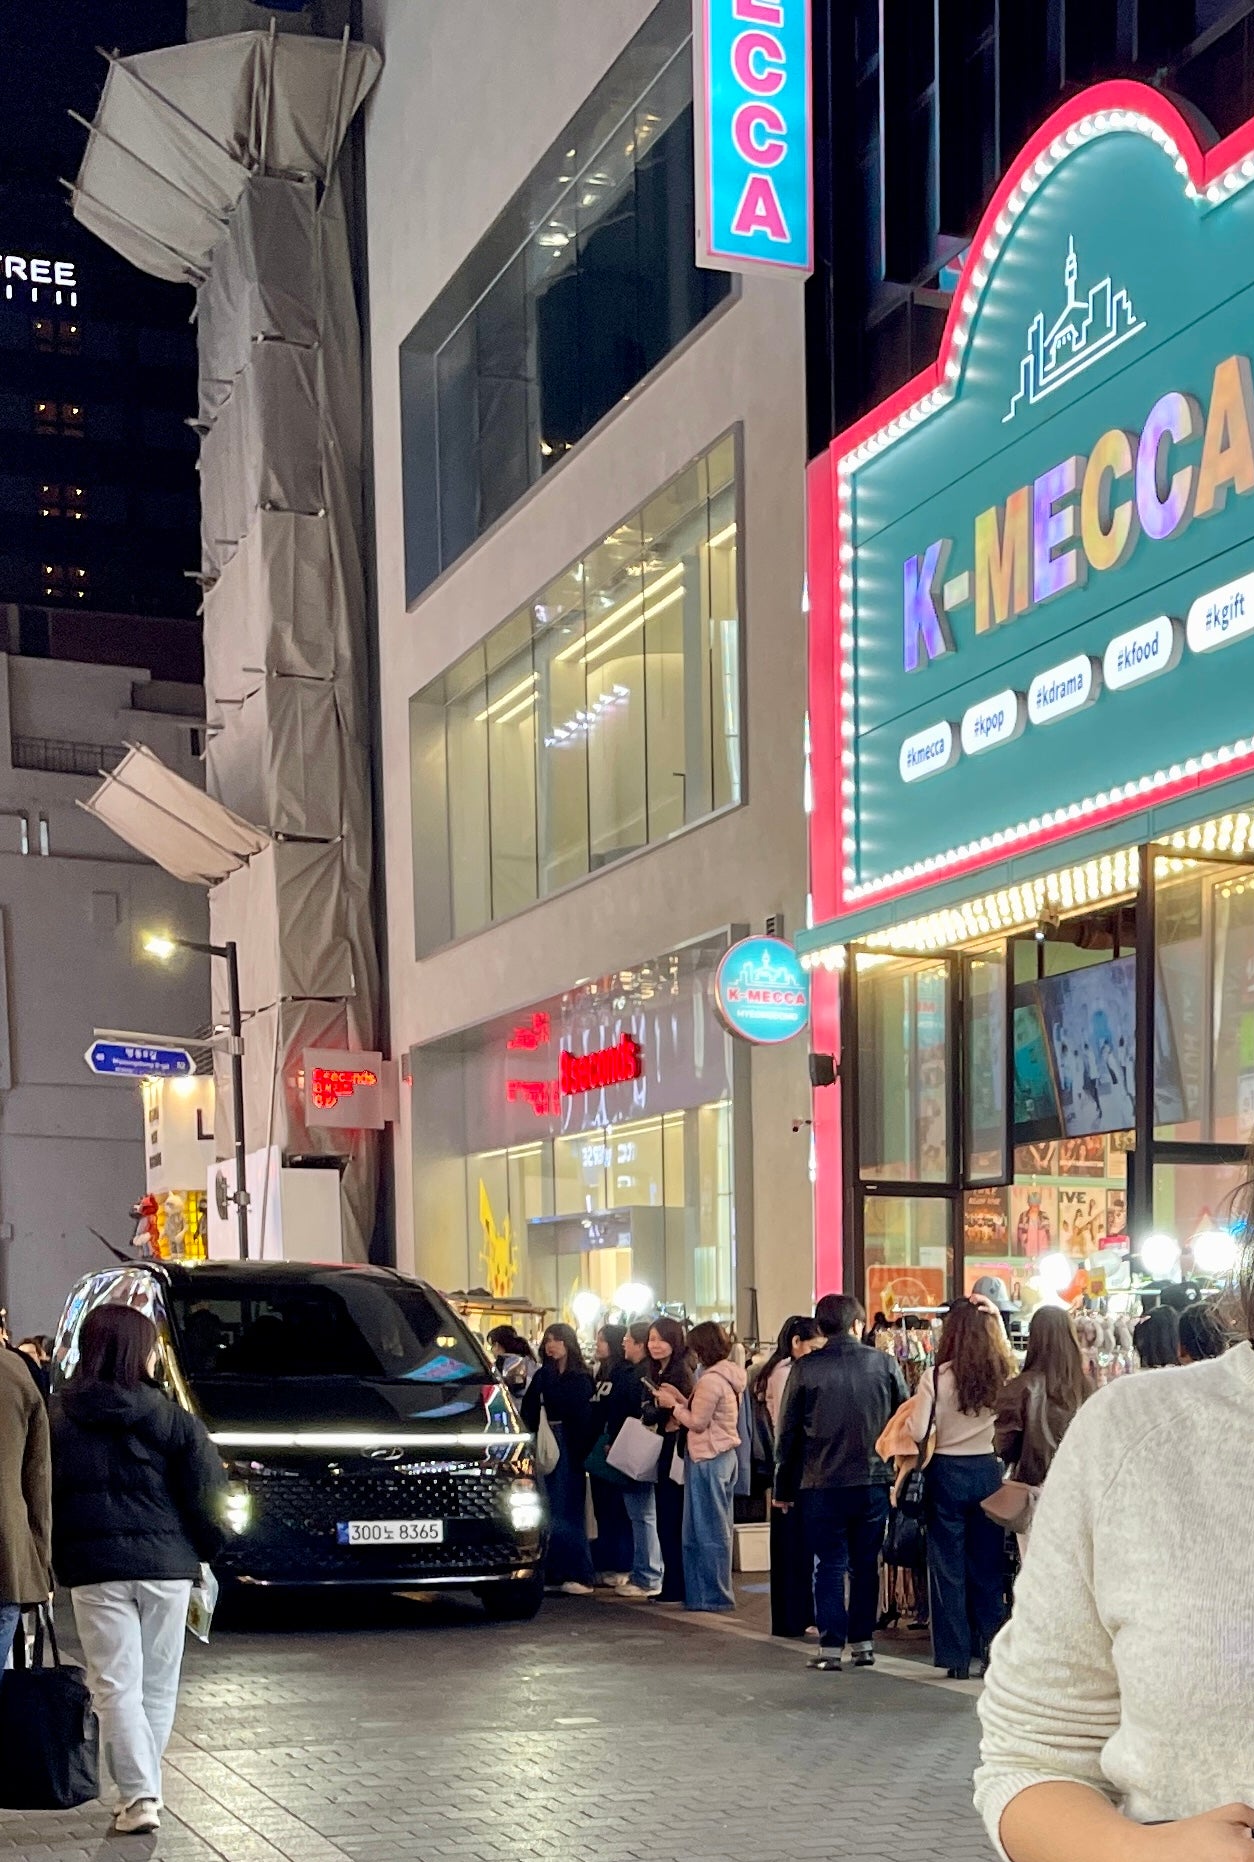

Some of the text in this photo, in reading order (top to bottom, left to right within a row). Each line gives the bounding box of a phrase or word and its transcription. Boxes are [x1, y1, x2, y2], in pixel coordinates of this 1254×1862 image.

[0, 254, 77, 287] REE
[1205, 592, 1245, 630] #kgift
[1117, 632, 1160, 672] #kfood
[1036, 672, 1083, 708] #kdrama
[974, 709, 1004, 739] #kpop
[906, 737, 945, 768] #kmecca
[726, 986, 807, 1006] K-MECCA
[351, 1524, 439, 1541] 300노 8365
